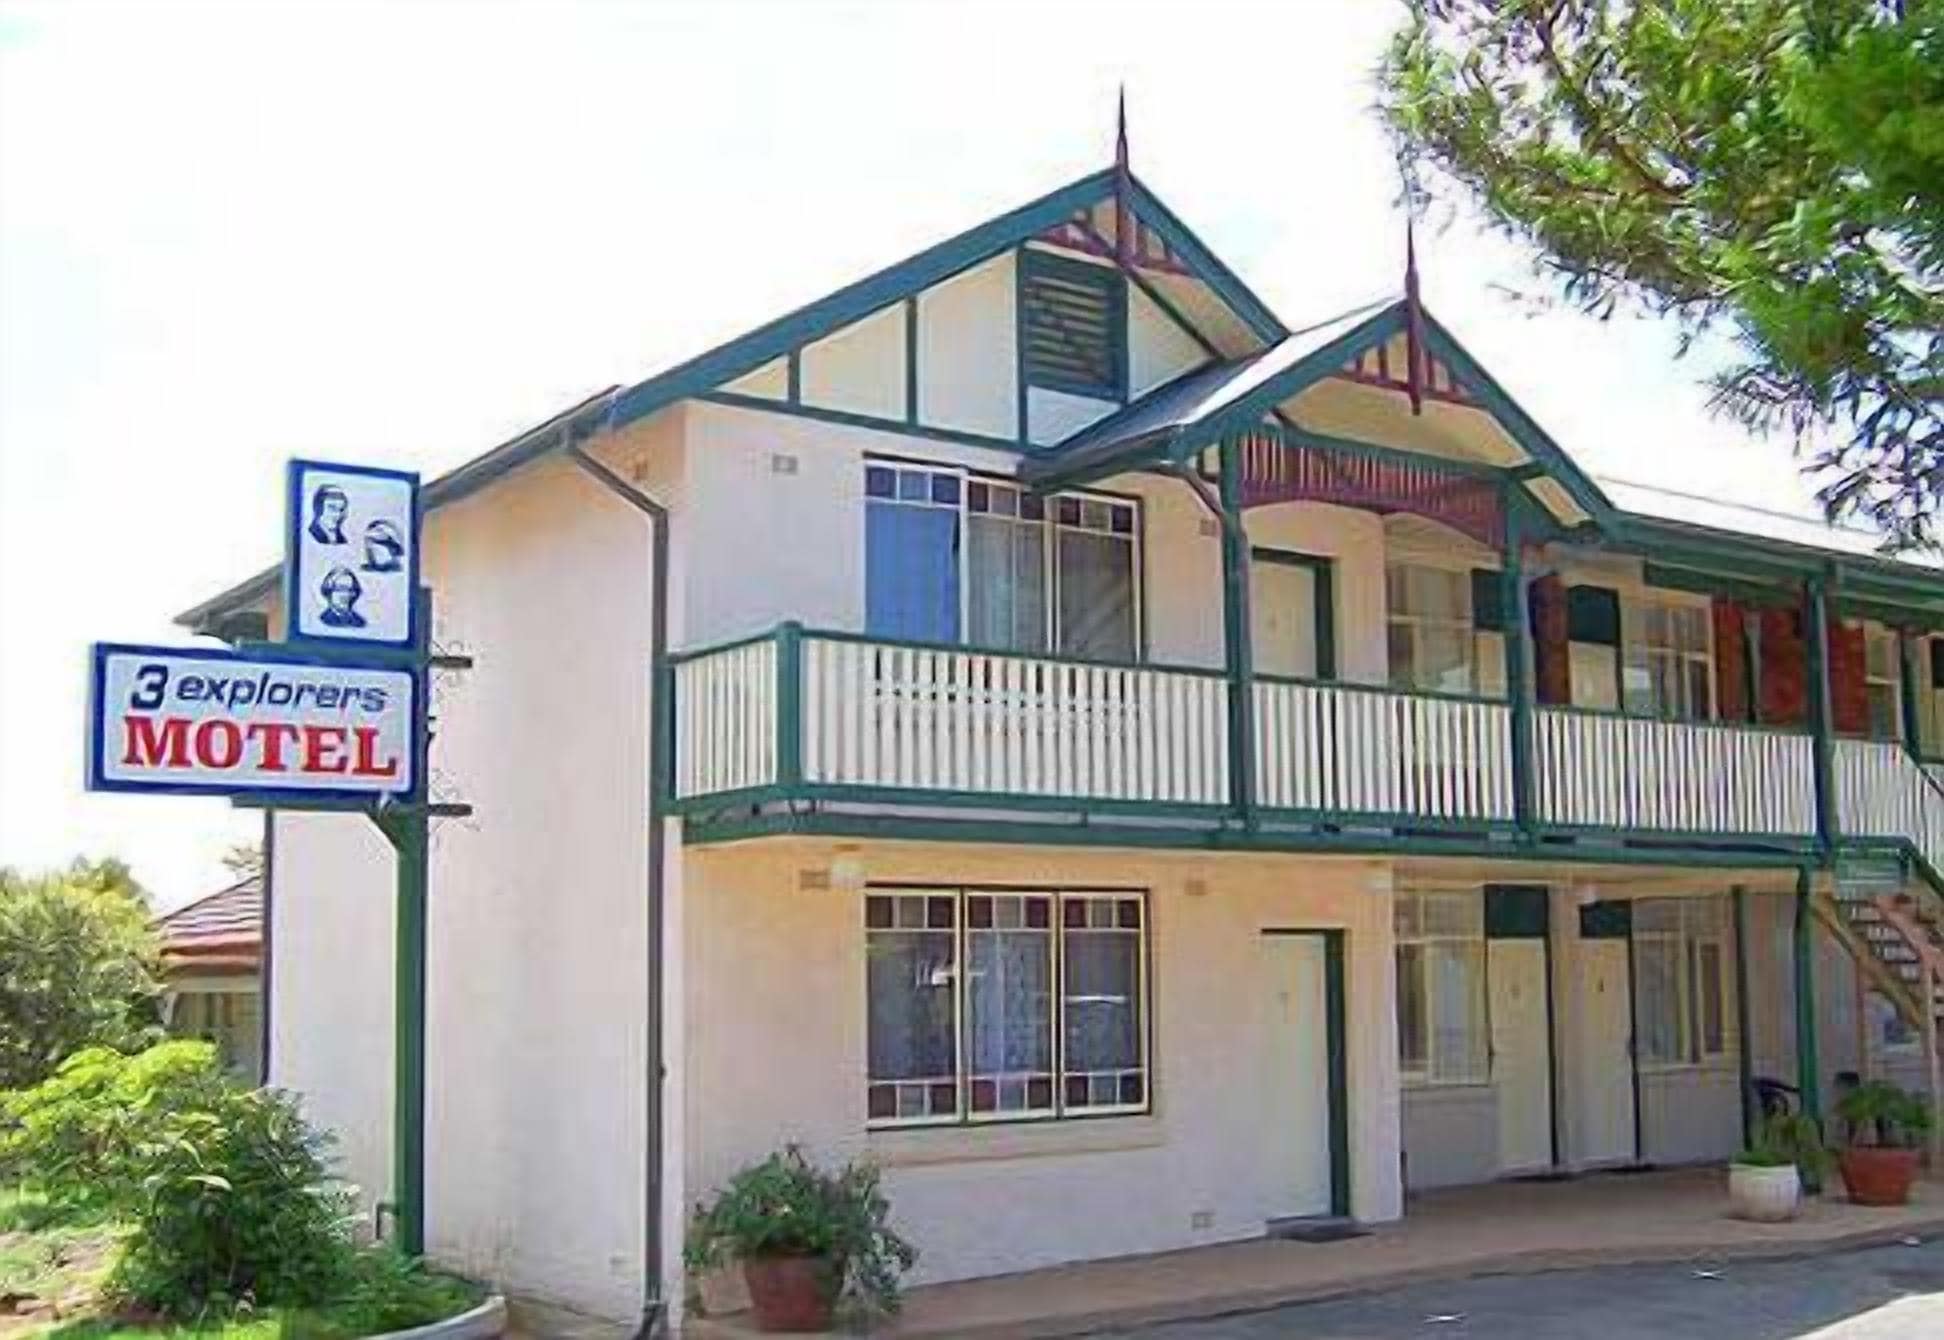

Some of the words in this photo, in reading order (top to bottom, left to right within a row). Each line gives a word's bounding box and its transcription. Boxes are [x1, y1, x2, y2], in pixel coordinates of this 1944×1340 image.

[131, 665, 169, 710] 3
[176, 672, 389, 713] explorers
[122, 715, 397, 777] MOTEL
